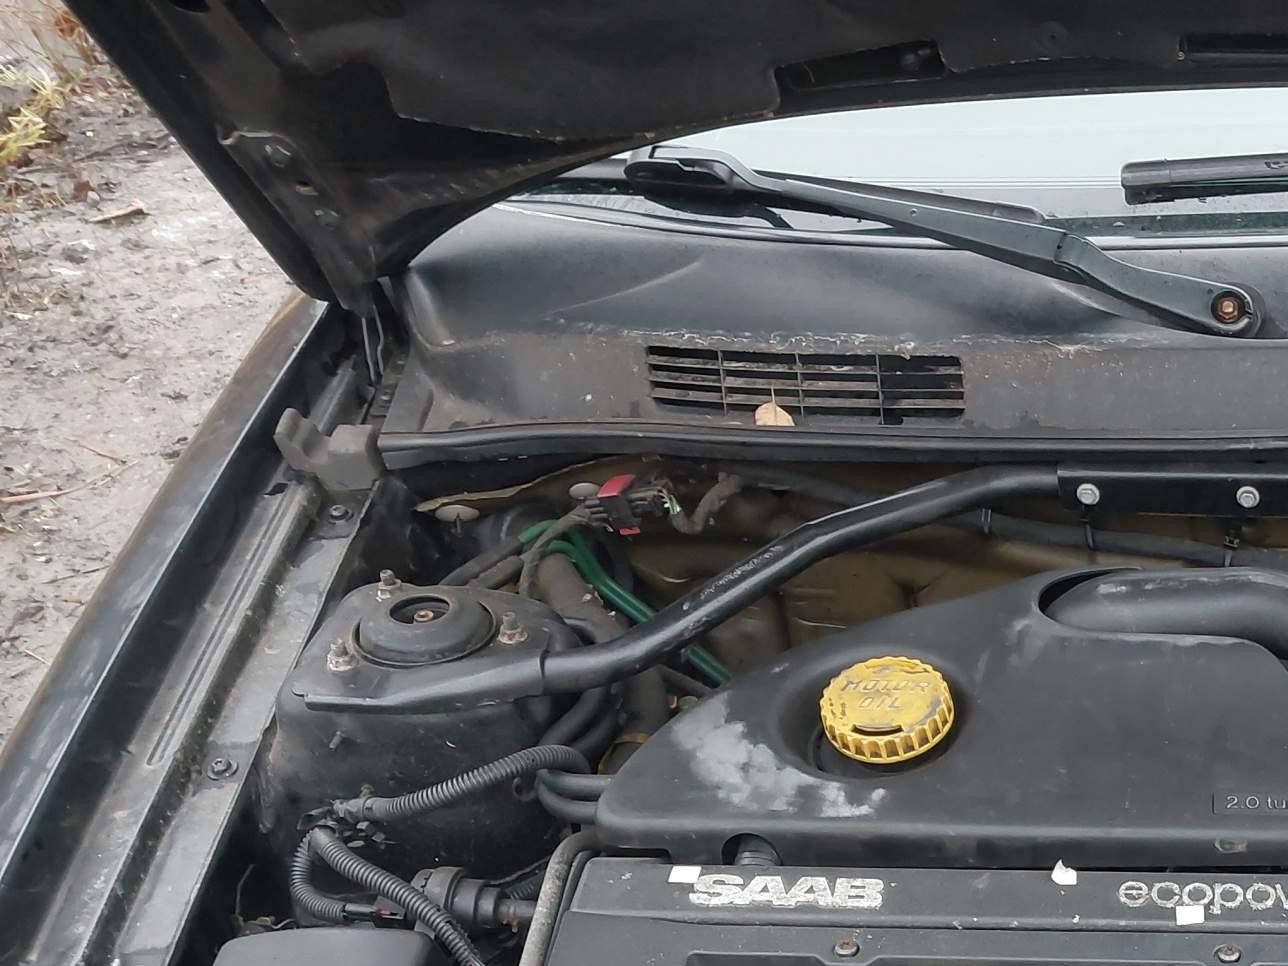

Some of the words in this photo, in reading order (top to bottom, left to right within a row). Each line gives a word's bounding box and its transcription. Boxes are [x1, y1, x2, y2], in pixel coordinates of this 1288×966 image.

[840, 679, 930, 693] MOTOR
[858, 695, 905, 709] OIL
[1225, 795, 1259, 810] 2.0
[689, 873, 884, 909] SAAB
